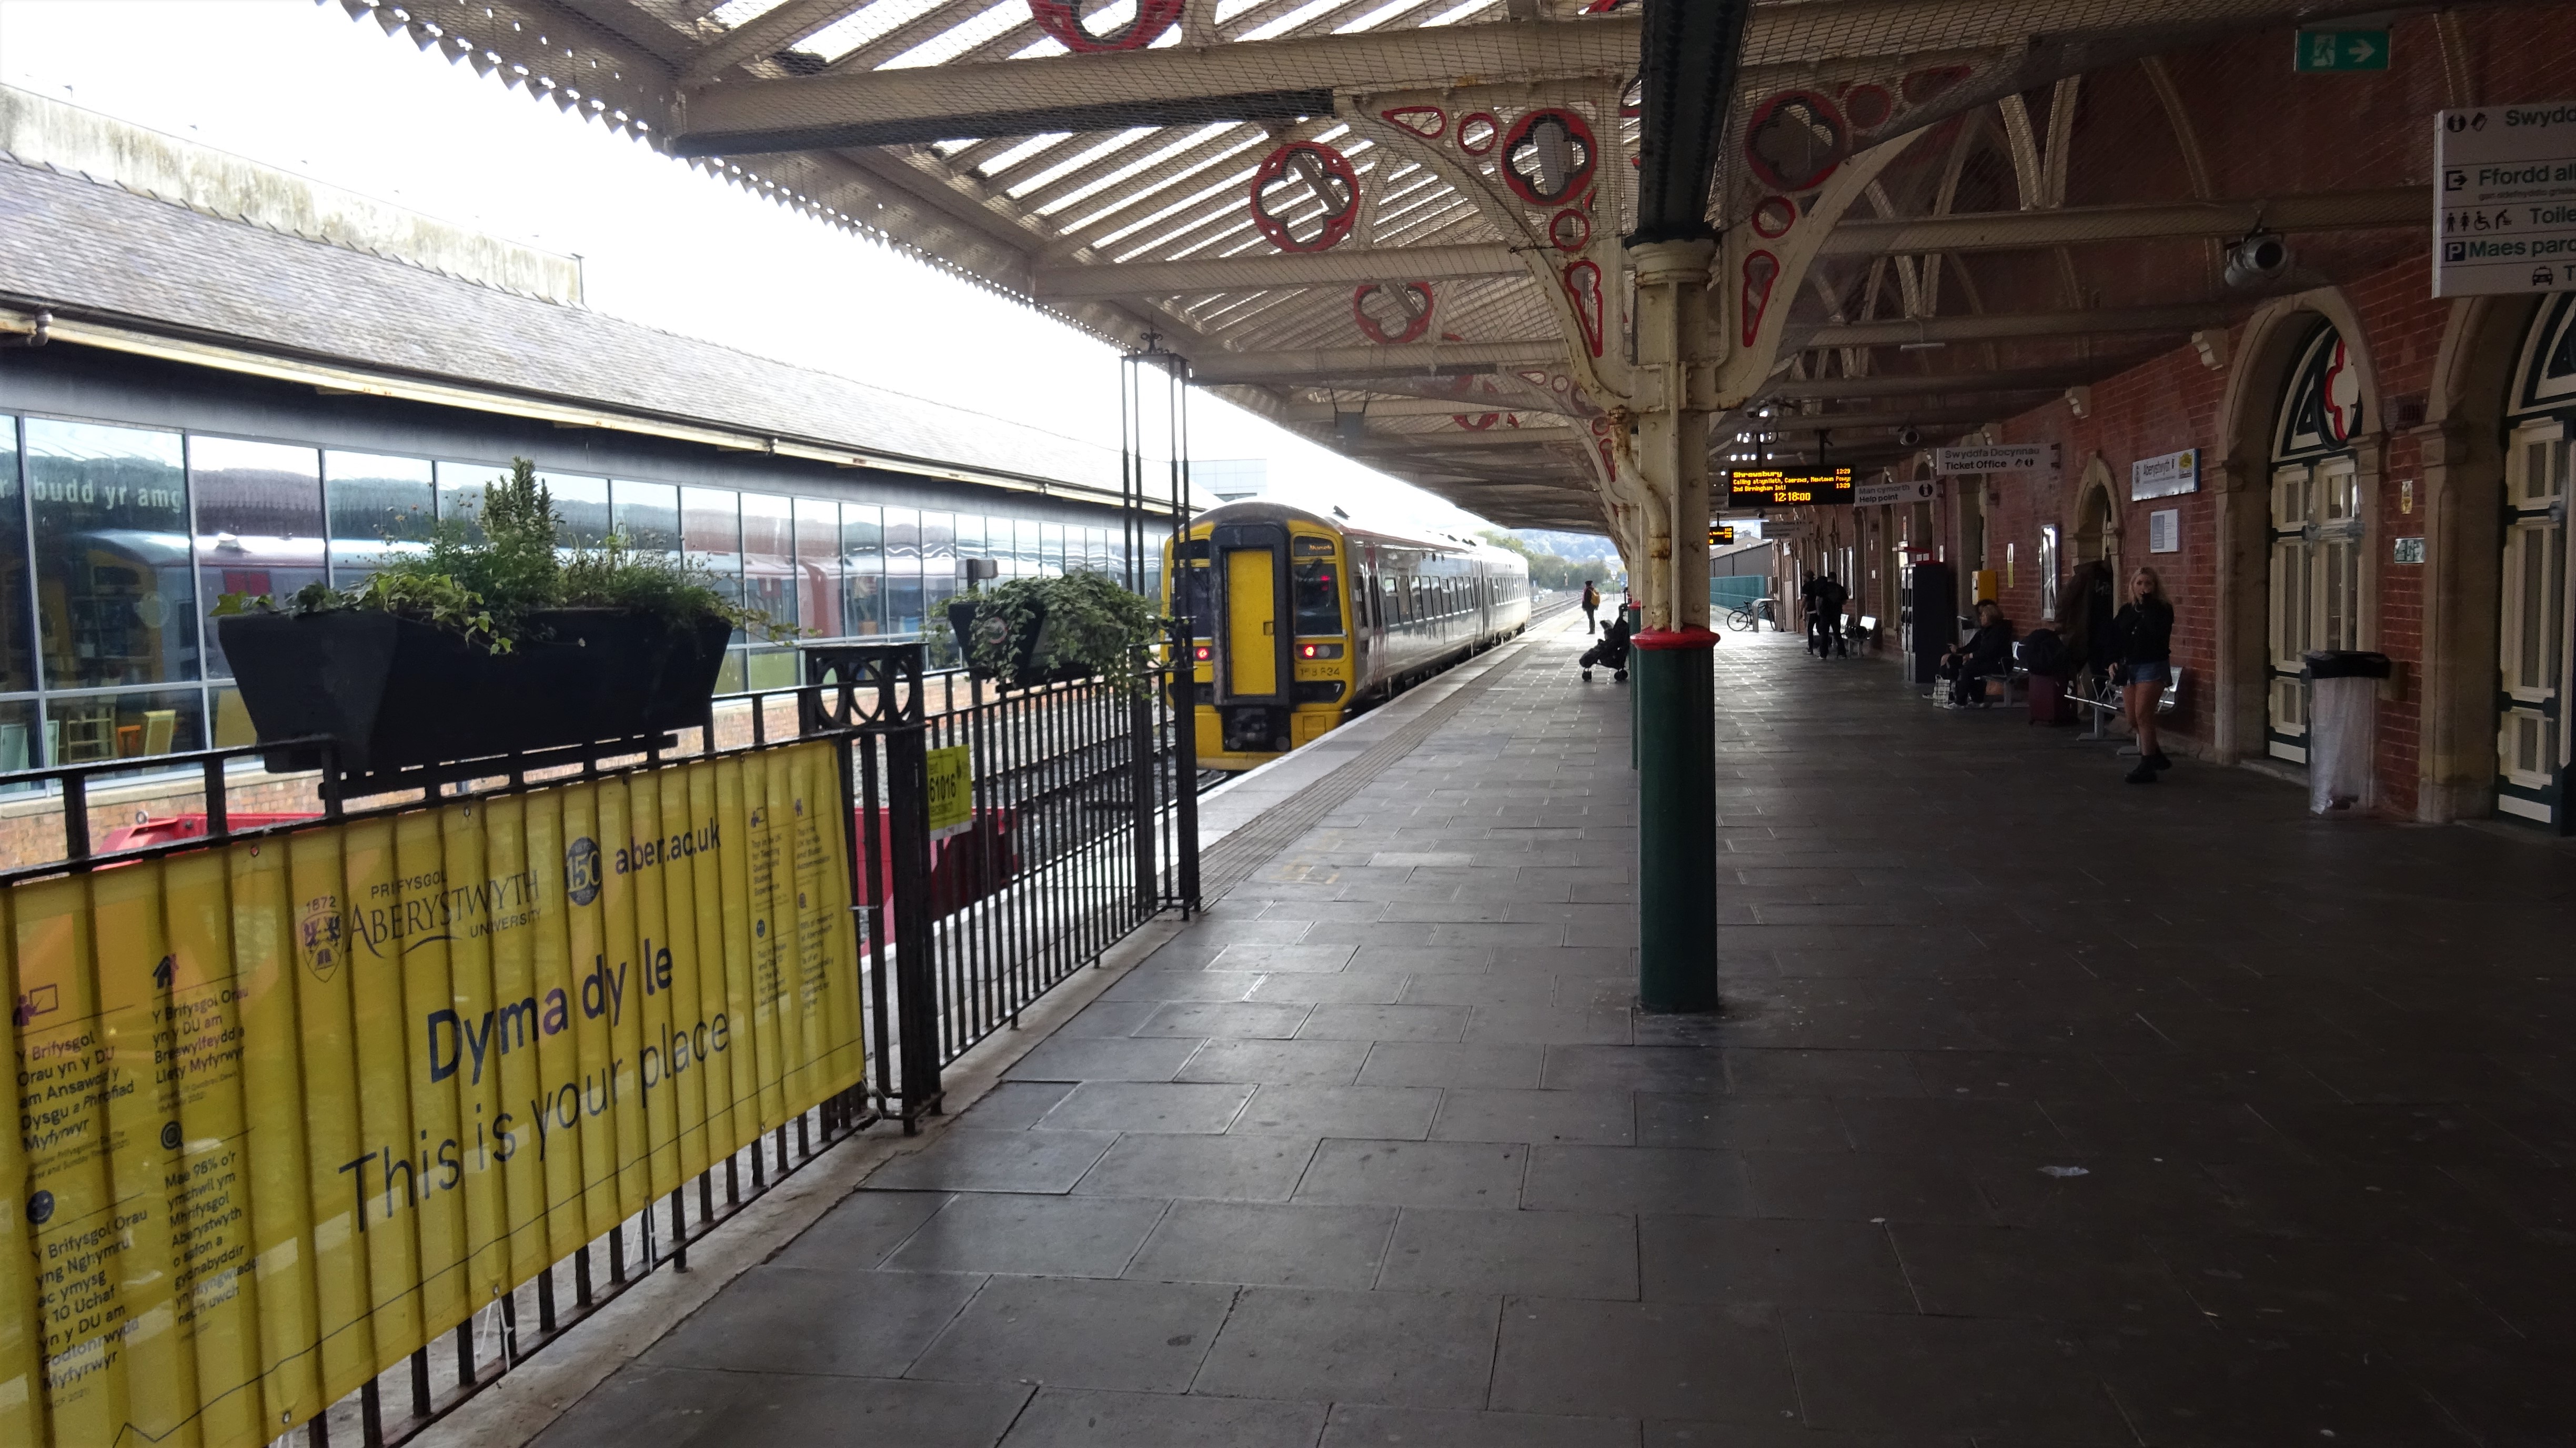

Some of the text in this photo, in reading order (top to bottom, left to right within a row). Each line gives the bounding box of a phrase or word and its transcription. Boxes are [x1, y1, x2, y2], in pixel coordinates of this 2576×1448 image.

[2479, 165, 2550, 187] Ffordd
[2469, 240, 2526, 258] Maes
[1945, 448, 2039, 459] Swyddfa Docynnau
[1945, 459, 2007, 470] Ticket Office
[33, 475, 94, 504] budd
[105, 484, 127, 510] yr
[1774, 492, 1811, 502] 12:18:00
[1877, 484, 1910, 494] cymorth
[1878, 493, 1898, 501] point
[1334, 683, 1341, 693] 7
[930, 773, 957, 803] 61016
[616, 818, 721, 875] aber.ac.uk
[371, 870, 448, 900] PRIFYSGOL
[567, 850, 602, 893] 150
[306, 869, 540, 955] 1872 ABERYSTWYTH
[470, 908, 542, 938] UNIVERSITY
[153, 987, 249, 1024] Y Brifysgol Orau
[427, 987, 568, 1085] Dyma
[582, 955, 627, 1026] dy
[645, 938, 673, 995] le
[33, 1031, 96, 1061] Brifysgol
[153, 1031, 169, 1048] yn
[183, 1018, 200, 1035] DU
[205, 1014, 223, 1029] am
[18, 1046, 115, 1088] Orau yn y DU
[190, 1045, 246, 1073] Myfyrwyr
[20, 1092, 42, 1110] am
[47, 1068, 110, 1101] Ansawdd
[21, 1107, 68, 1131] Dysgu
[73, 1102, 80, 1114] a
[338, 1012, 730, 1233] This is your place
[23, 1118, 90, 1152] Myfyrwyr
[165, 1151, 236, 1189] Mae 98% o'r
[168, 1172, 236, 1212] ymchwil ym
[170, 1191, 229, 1229] Mhrifysgol
[48, 1221, 112, 1260] Brifysgol
[114, 1209, 148, 1231] Orau
[172, 1207, 243, 1248] Aberystwyth
[35, 1237, 131, 1291] yng Nghymru
[174, 1255, 180, 1268] o
[216, 1235, 223, 1246] a
[175, 1244, 245, 1292] gydnabyddir
[37, 1269, 107, 1309] ac ymysg
[53, 1305, 71, 1324] 10
[75, 1283, 116, 1314] Uchaf
[176, 1292, 189, 1310] yn
[209, 1285, 240, 1309] uwch
[39, 1304, 126, 1353] yn y DU am
[41, 1316, 140, 1371] Fodlonrwydd
[42, 1350, 118, 1392] Myfyrwyr
